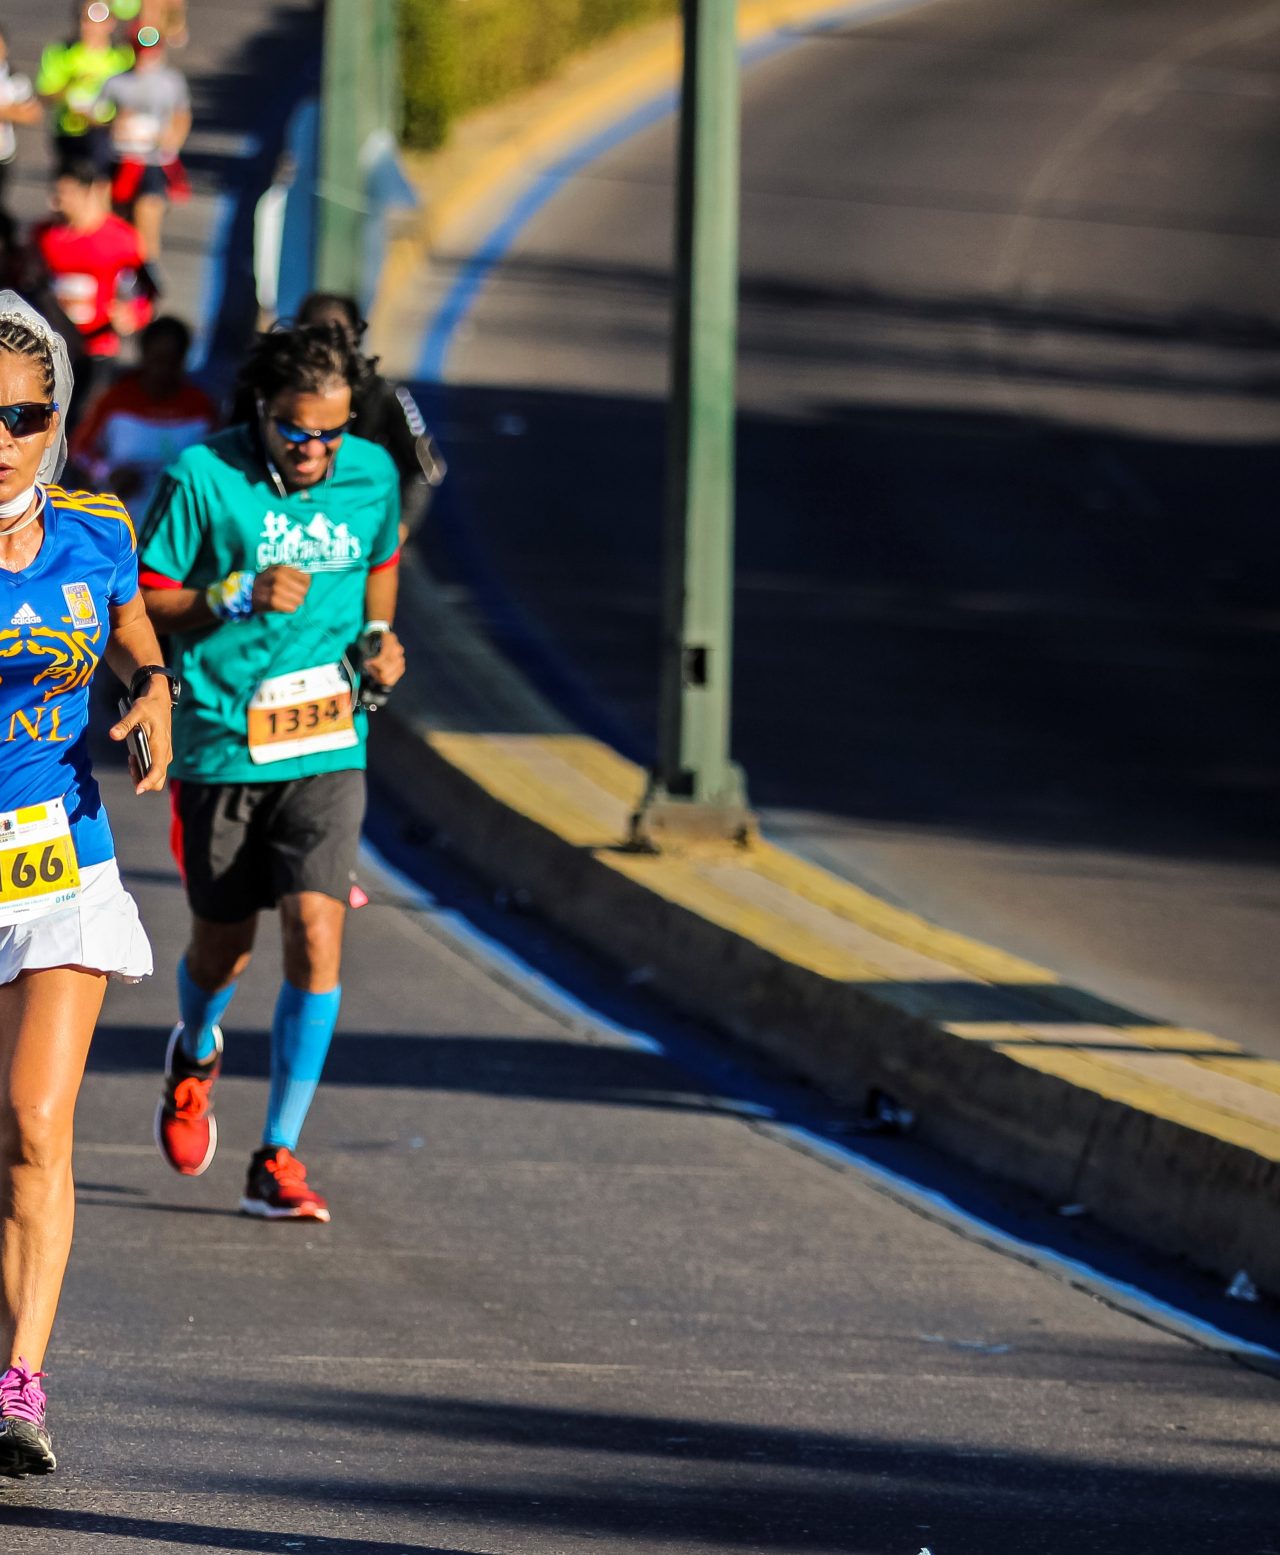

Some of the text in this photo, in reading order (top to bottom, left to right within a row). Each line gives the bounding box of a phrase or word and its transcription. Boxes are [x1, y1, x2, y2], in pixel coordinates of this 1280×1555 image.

[11, 616, 41, 625] adidas
[268, 700, 339, 734] 1334
[55, 892, 76, 904] 0166
